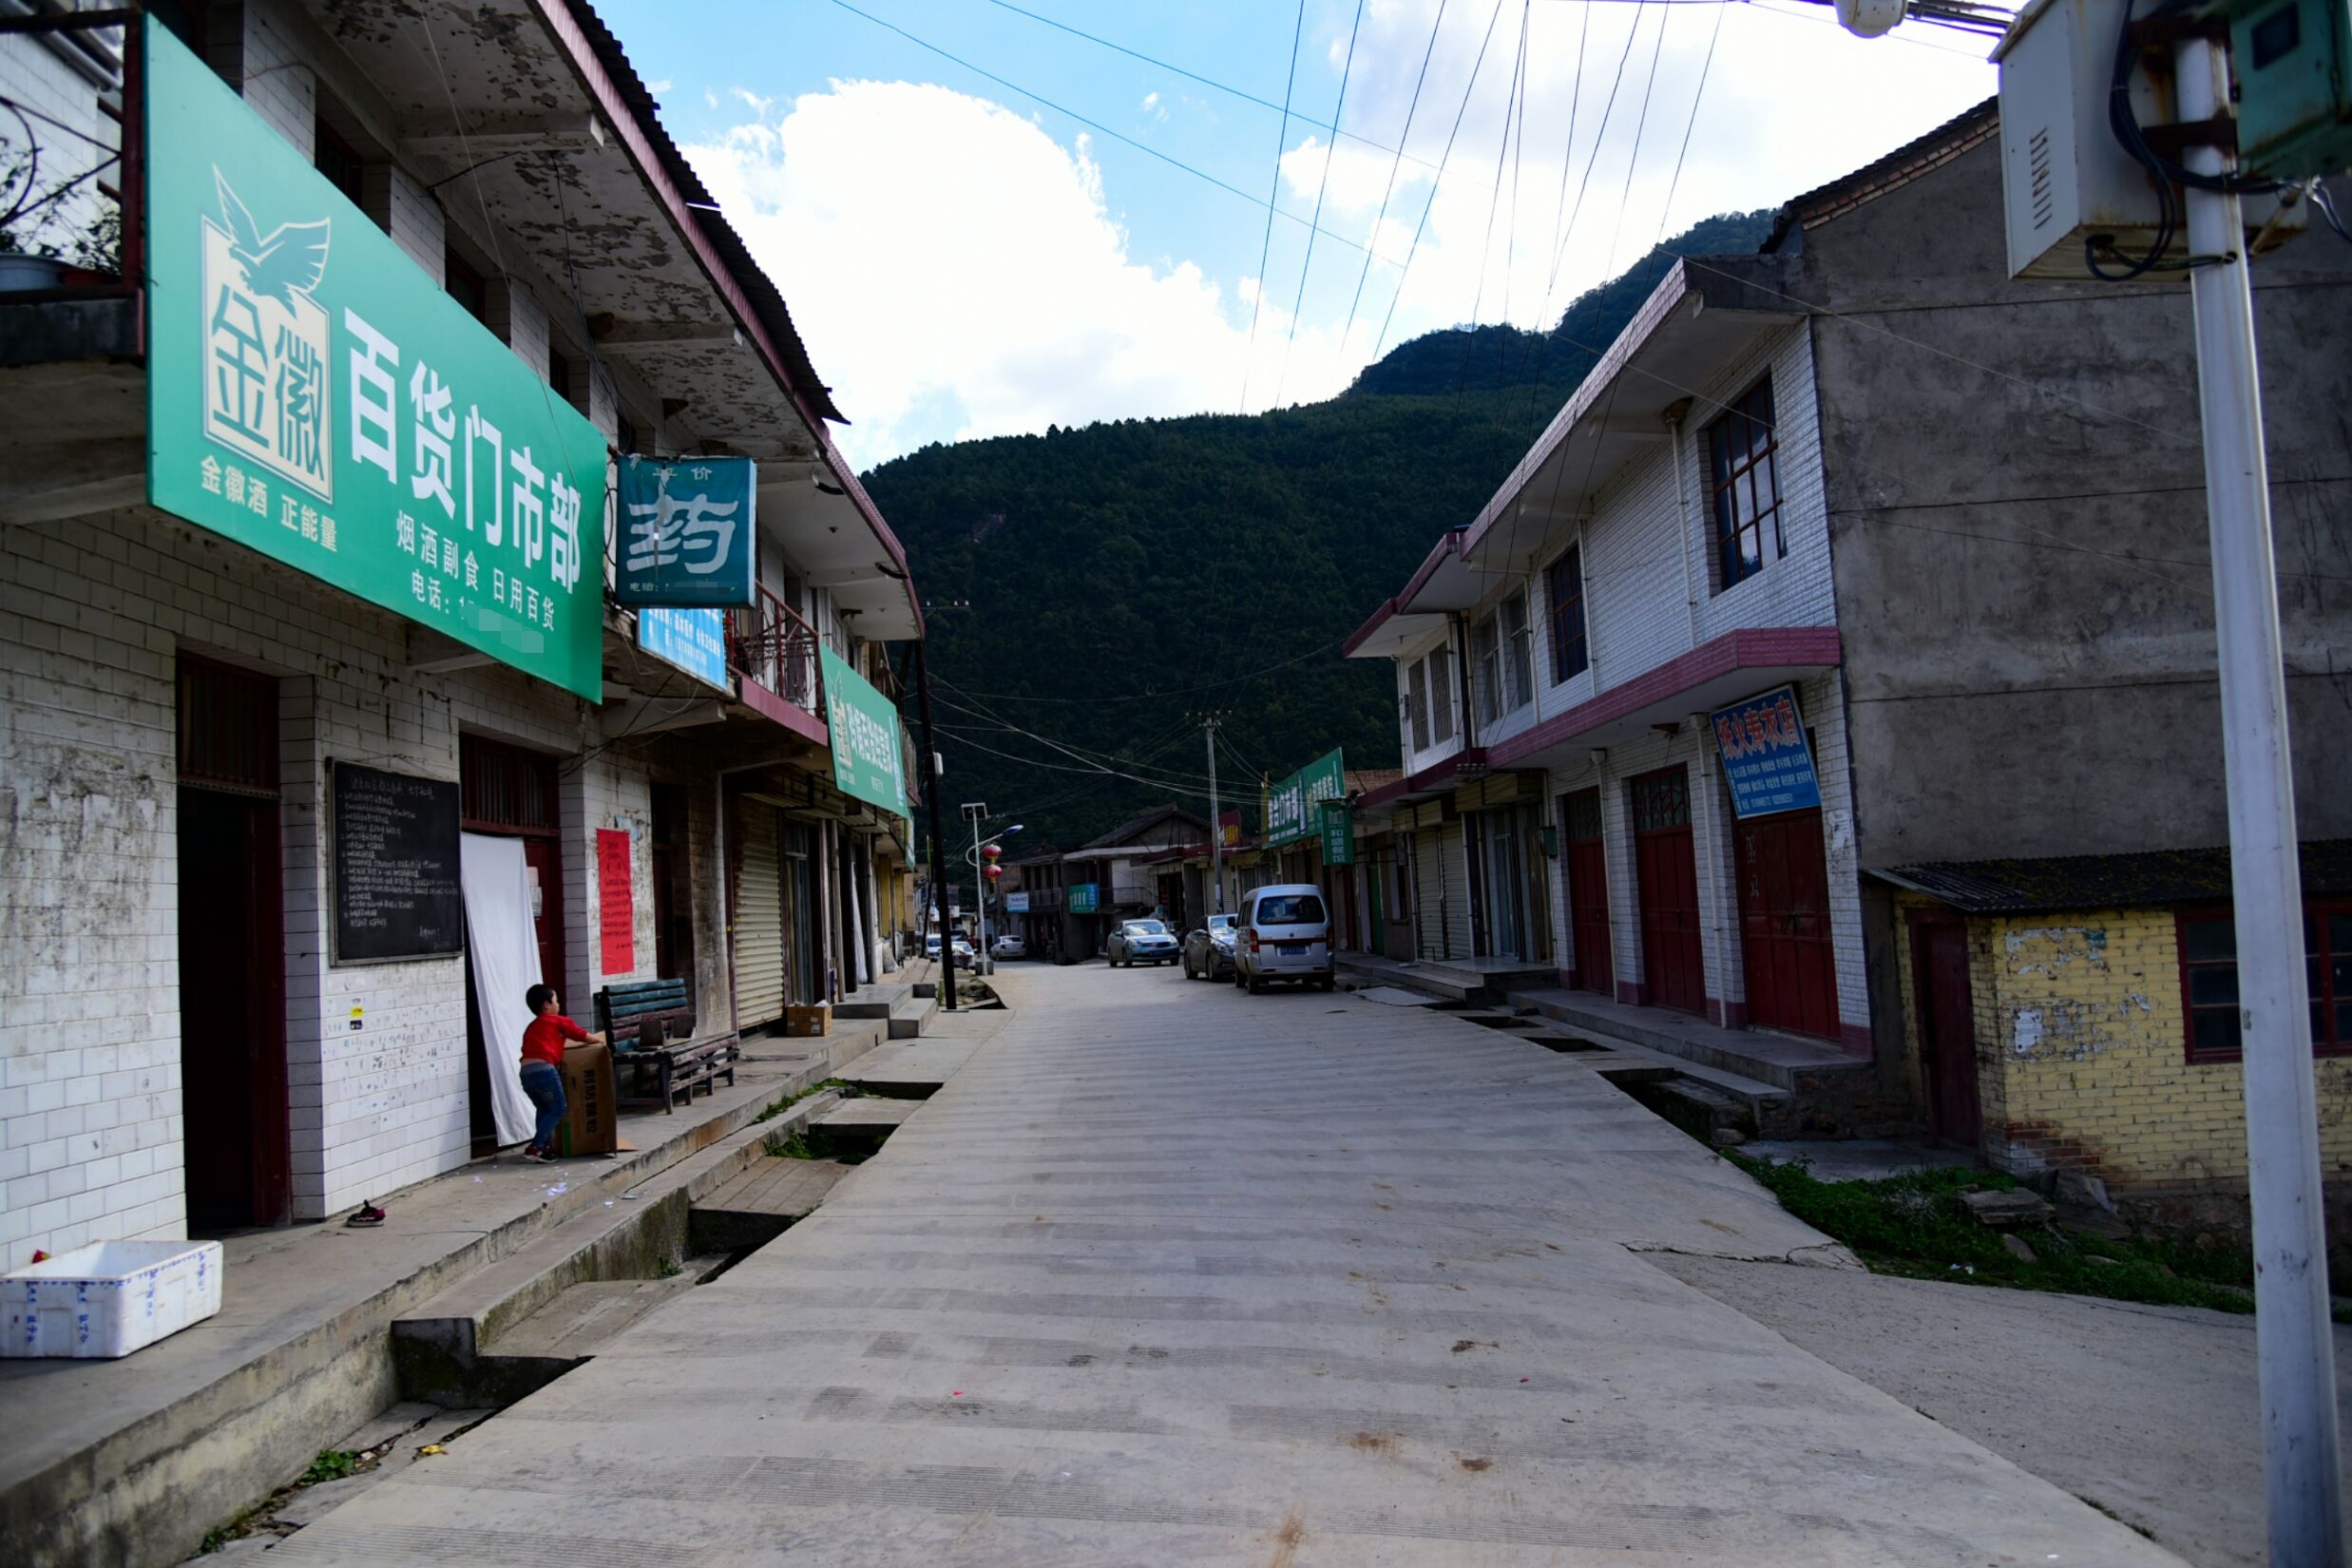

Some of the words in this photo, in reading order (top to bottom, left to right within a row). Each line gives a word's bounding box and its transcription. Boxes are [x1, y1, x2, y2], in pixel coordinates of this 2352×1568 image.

[212, 284, 326, 482] 金徽
[200, 454, 268, 519] 金徽酒
[280, 493, 338, 553] 正能量
[344, 306, 582, 595] 百货门市部
[395, 509, 479, 593] 烟酒副食
[491, 567, 555, 633] 日用百货
[626, 493, 738, 574] 药
